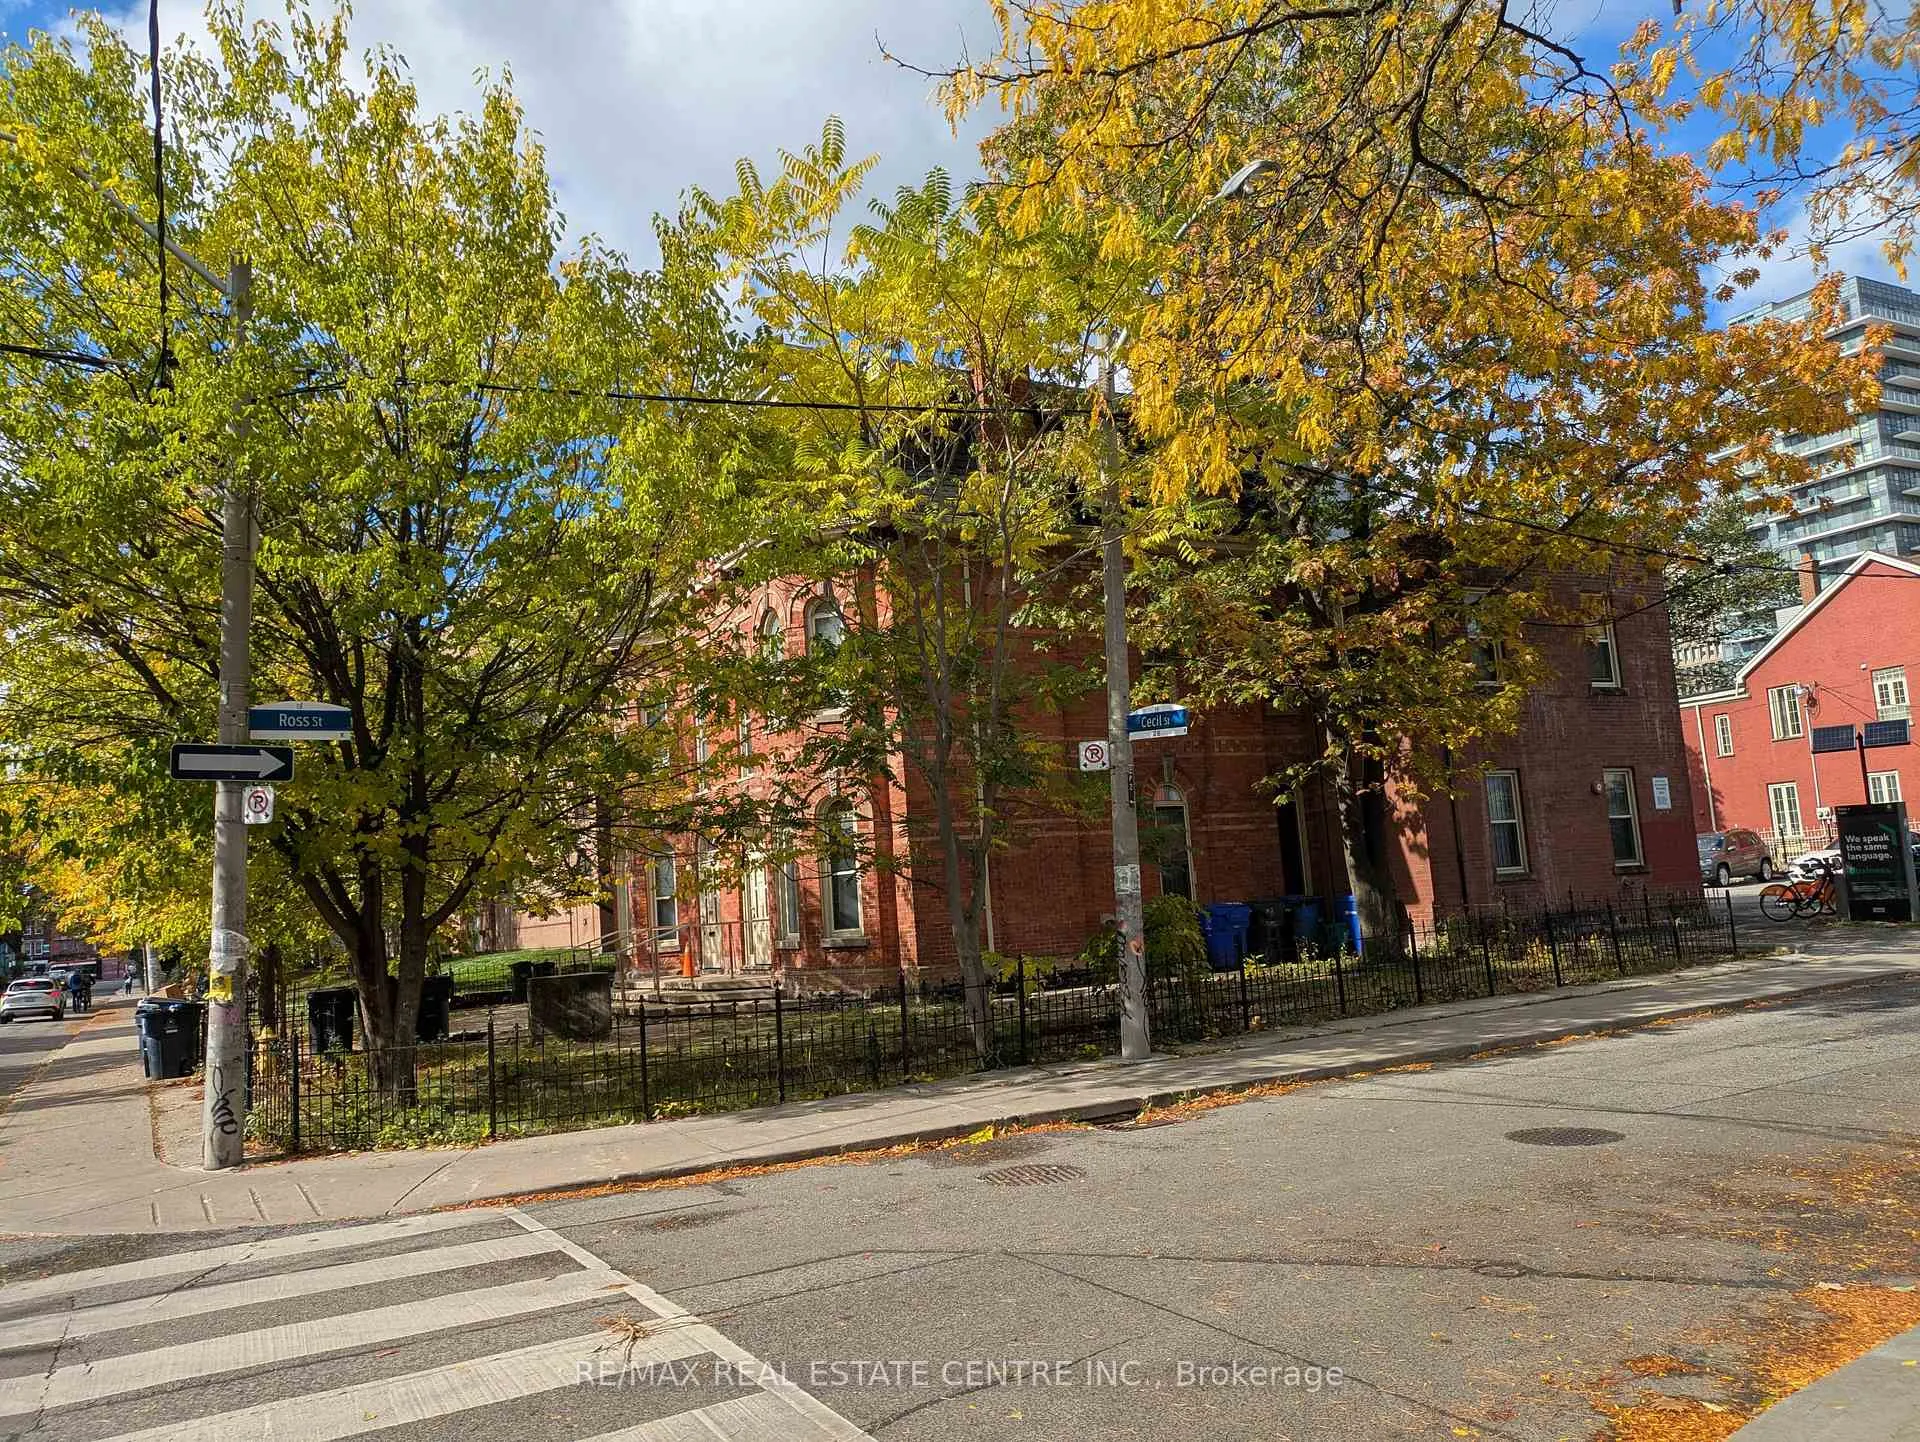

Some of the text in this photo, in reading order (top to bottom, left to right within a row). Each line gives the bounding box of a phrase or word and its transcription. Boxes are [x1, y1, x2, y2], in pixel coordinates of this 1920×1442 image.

[280, 713, 323, 728] Ross St
[1141, 714, 1162, 728] Cecil
[1845, 832, 1889, 844] We speak
[1848, 852, 1893, 861] language.
